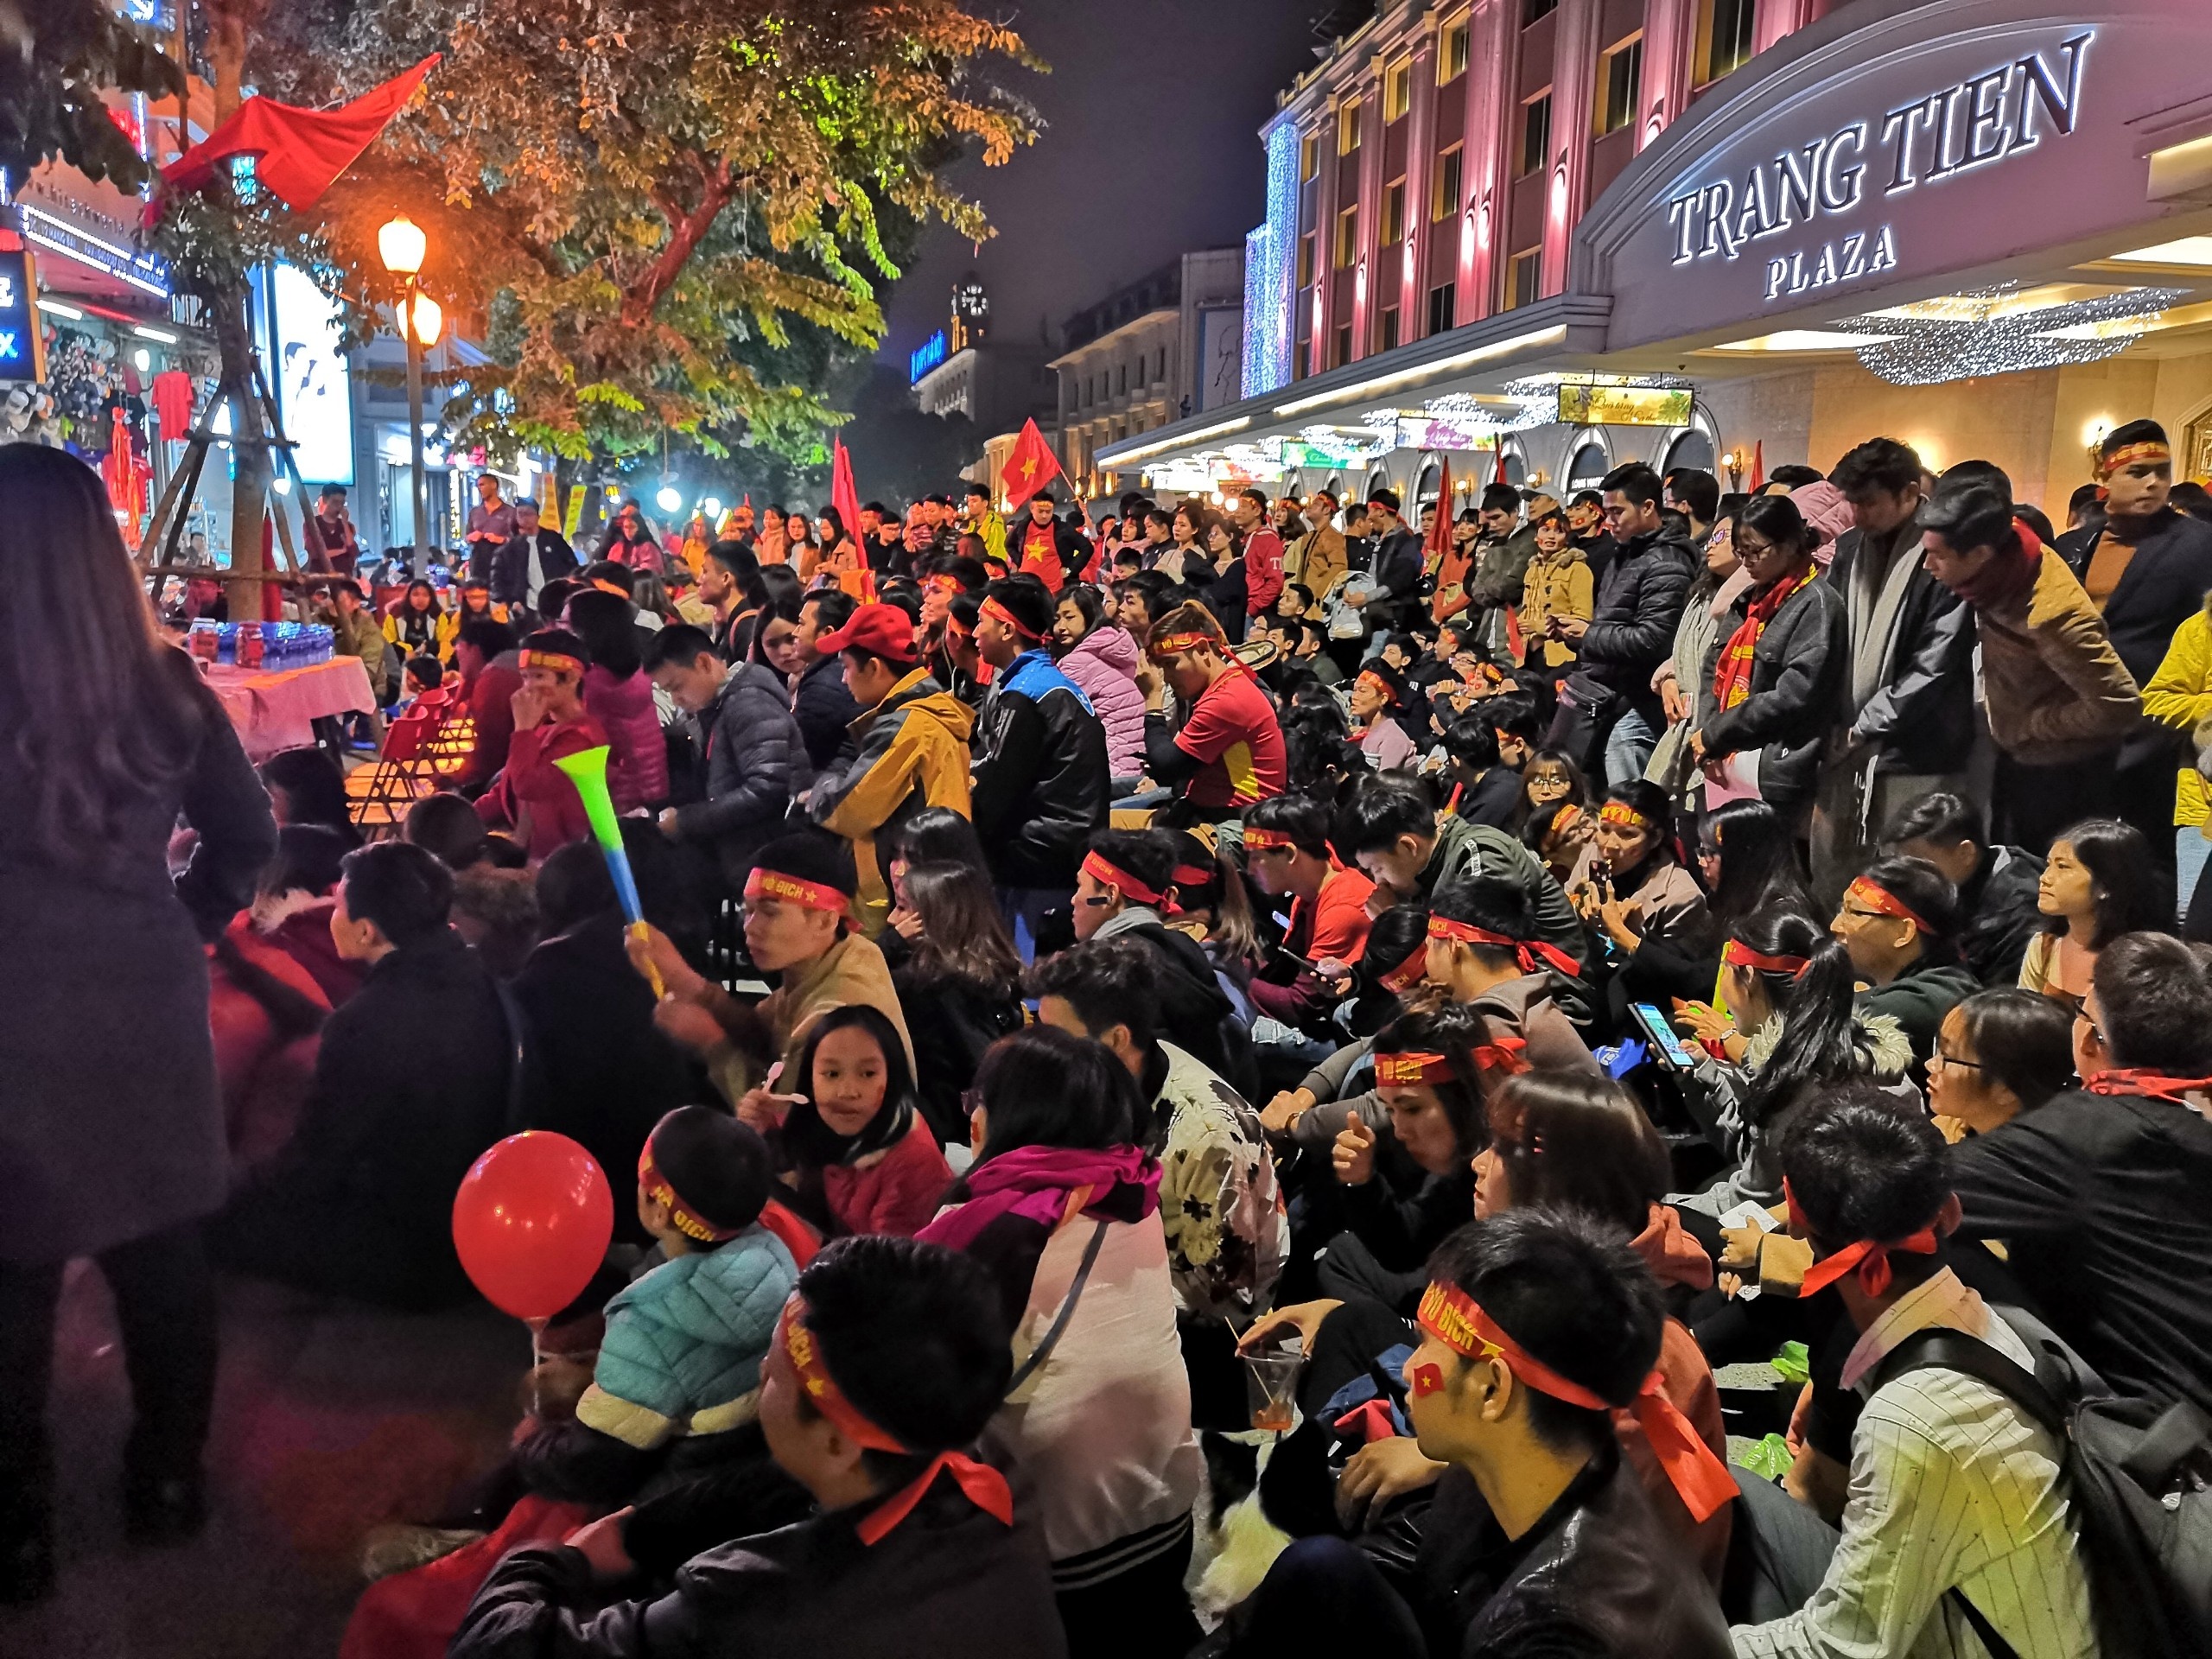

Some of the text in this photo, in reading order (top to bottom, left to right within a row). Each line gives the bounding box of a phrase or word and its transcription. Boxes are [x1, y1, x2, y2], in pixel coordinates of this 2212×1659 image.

[1669, 30, 2096, 266] TRANG TIEN
[1764, 225, 1898, 301] PLAZA
